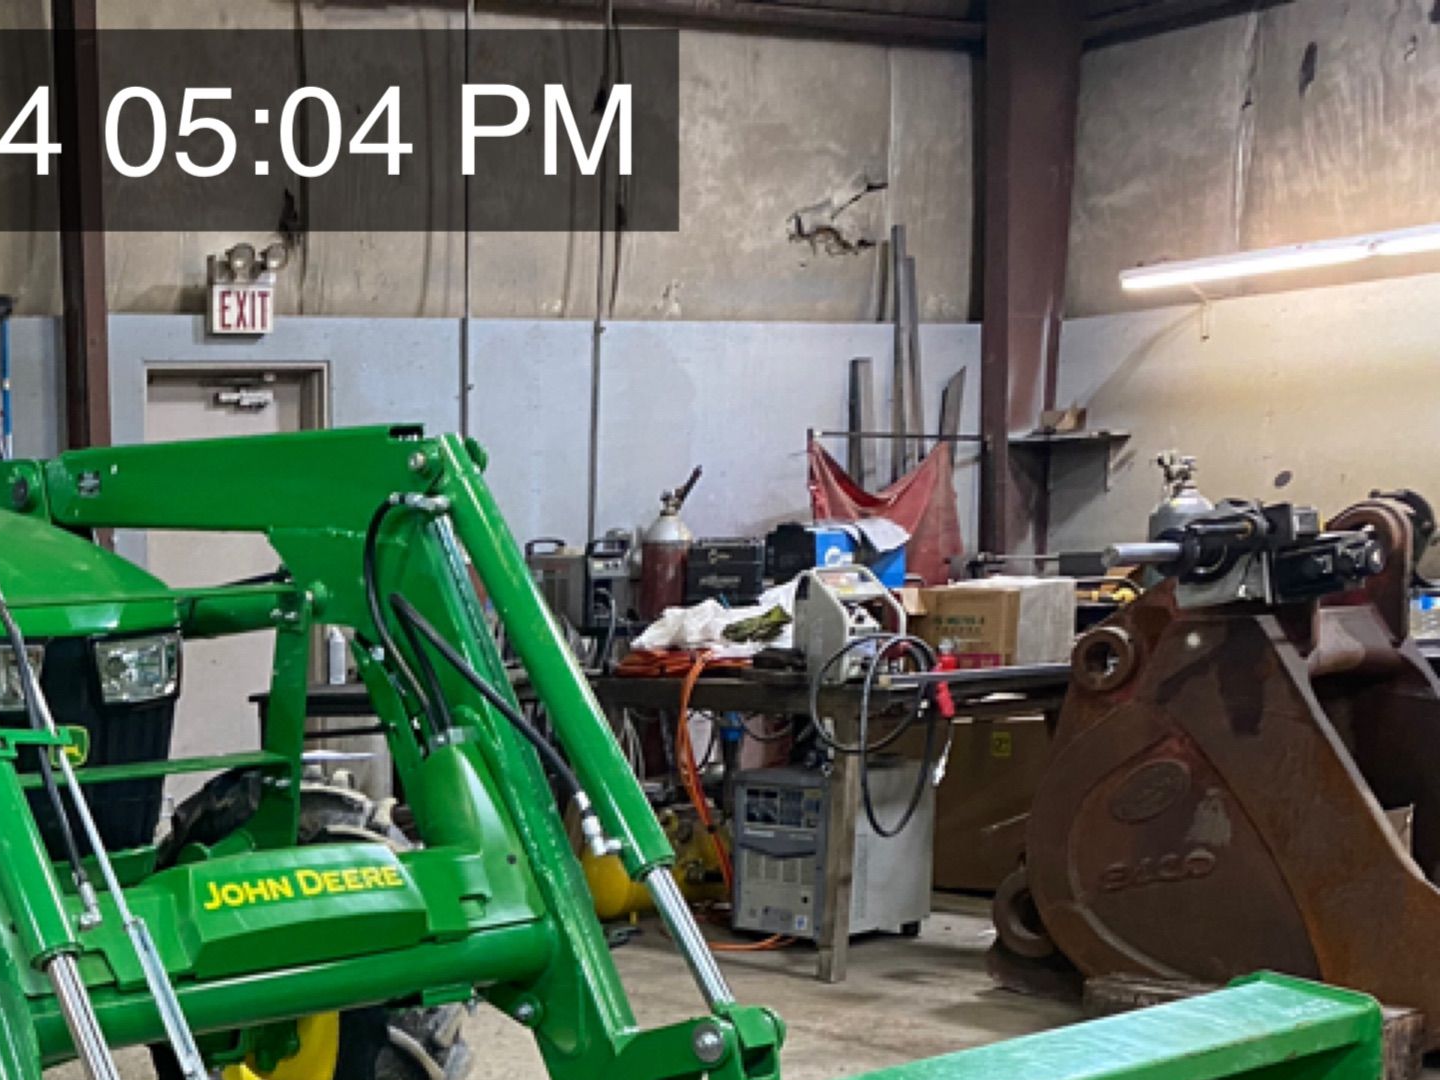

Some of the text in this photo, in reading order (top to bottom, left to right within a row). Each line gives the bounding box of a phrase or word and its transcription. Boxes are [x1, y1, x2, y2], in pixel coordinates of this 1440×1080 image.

[220, 290, 270, 330] EXIT
[204, 866, 403, 910] JOHN DEERE
